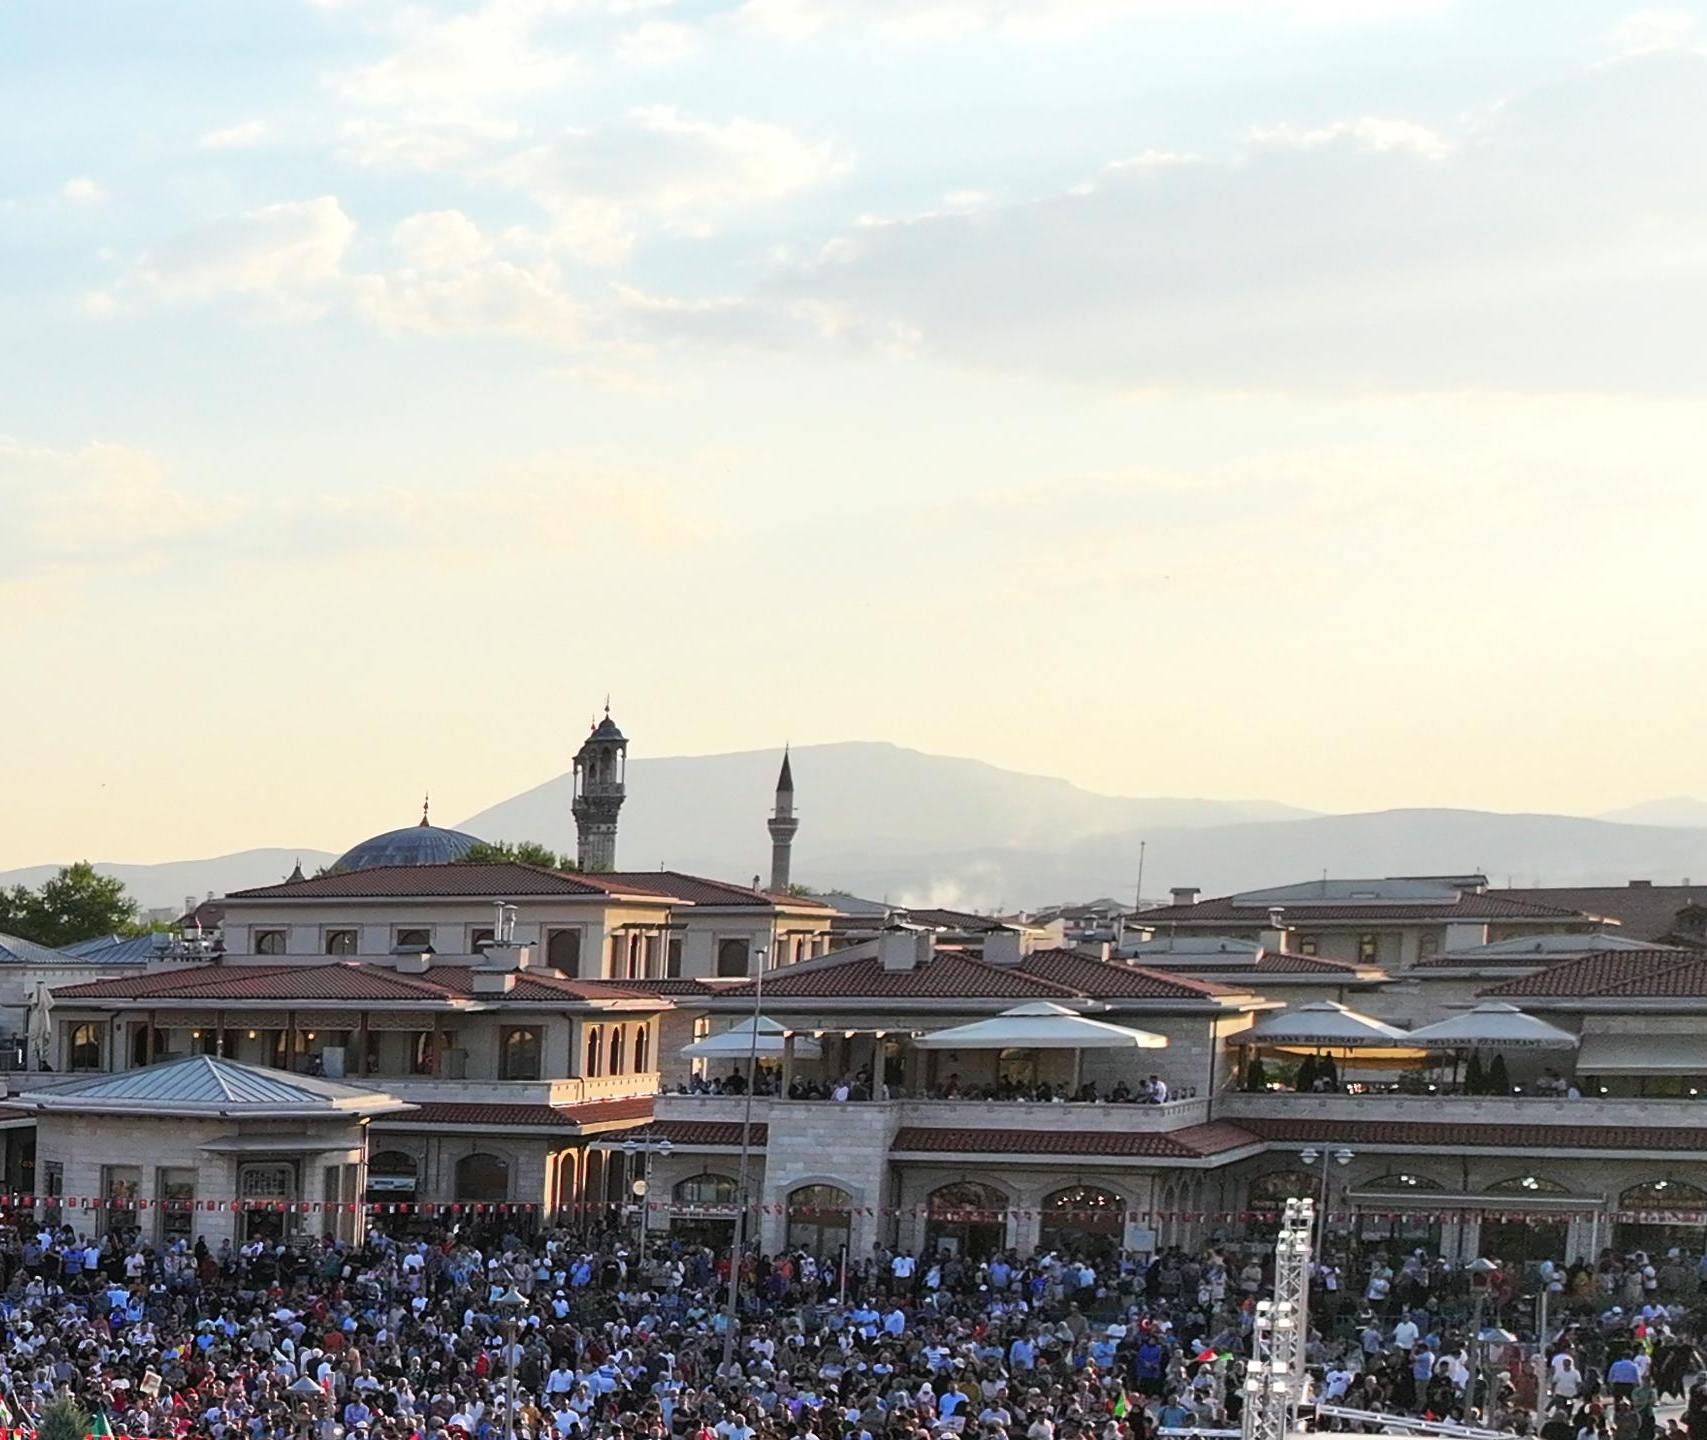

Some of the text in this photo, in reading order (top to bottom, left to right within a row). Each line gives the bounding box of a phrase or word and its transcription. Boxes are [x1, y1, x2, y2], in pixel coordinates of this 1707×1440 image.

[1256, 1035, 1366, 1045] MEVLANA RESTAURANT
[1426, 1038, 1542, 1047] MEVLANA RESTAURANT
